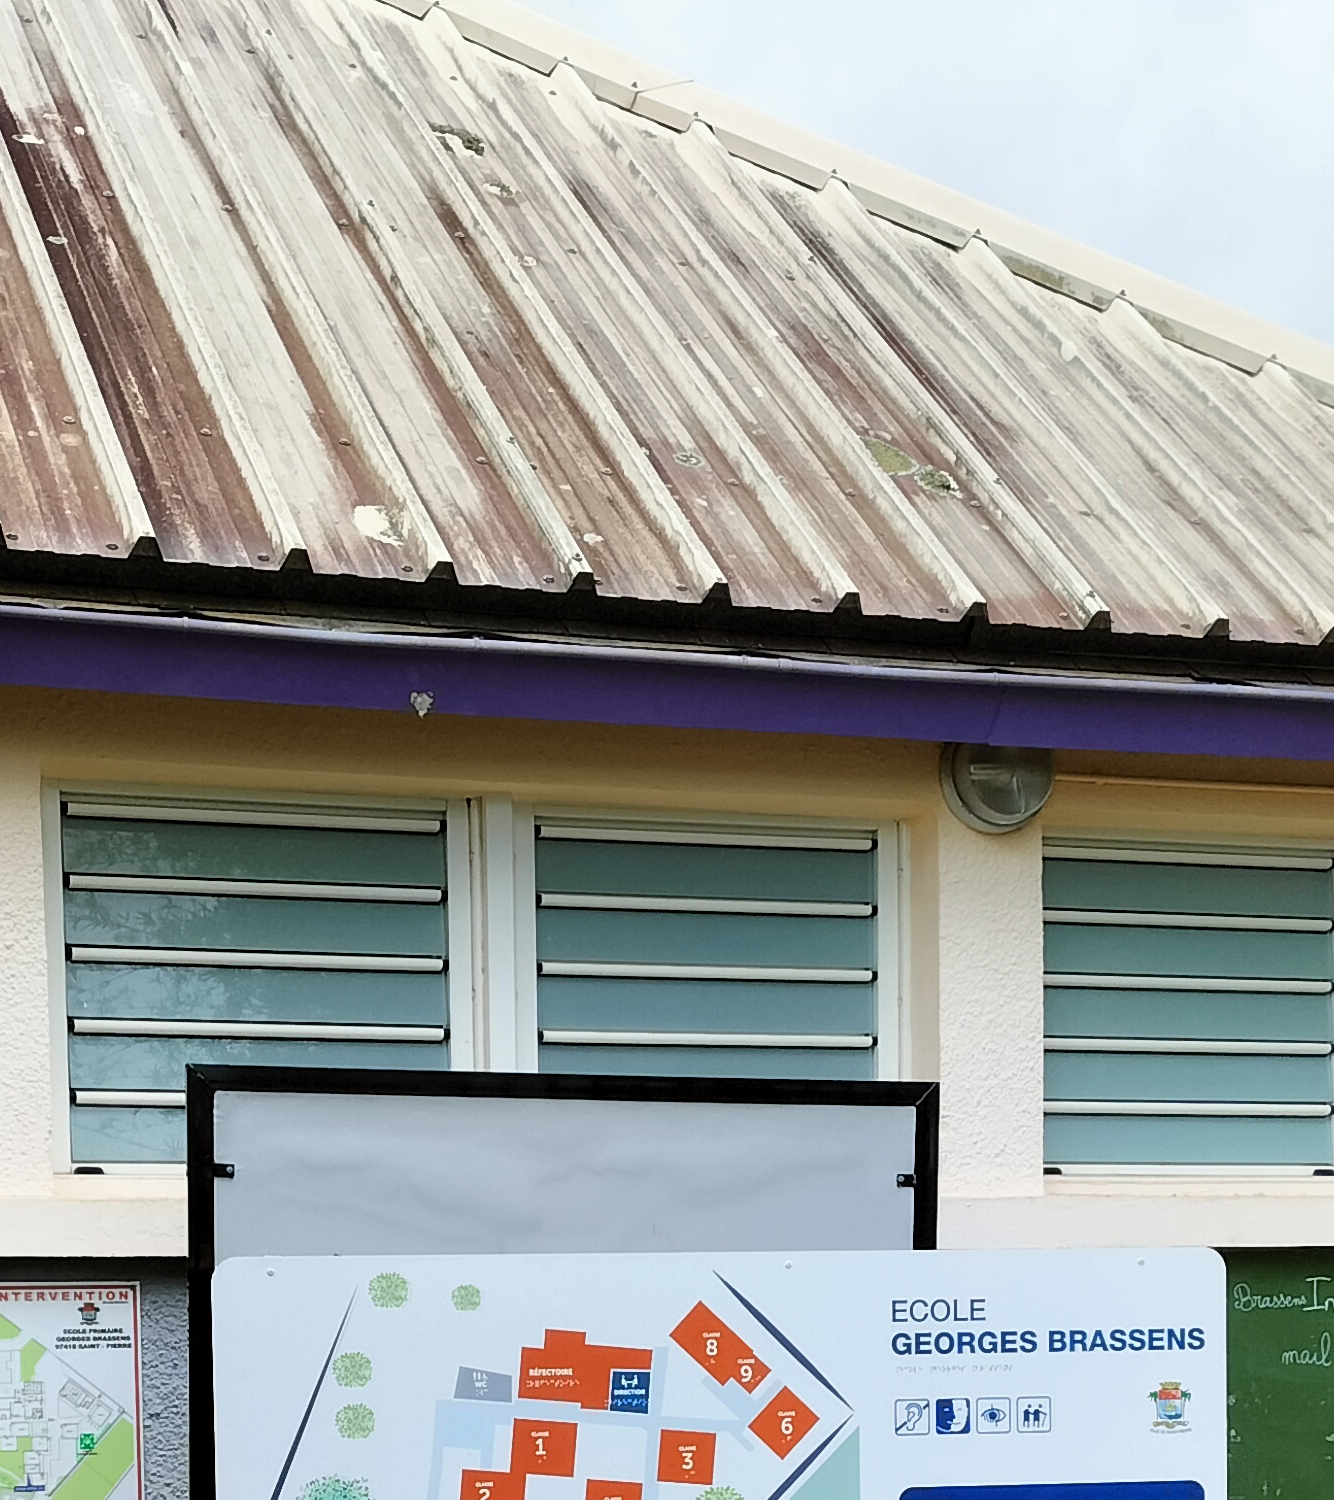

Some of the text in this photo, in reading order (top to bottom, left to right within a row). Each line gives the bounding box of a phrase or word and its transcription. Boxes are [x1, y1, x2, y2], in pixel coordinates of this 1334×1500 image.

[1233, 1283, 1307, 1311] Brassens
[891, 1298, 987, 1323] ECOLE
[705, 1339, 718, 1356] 8
[891, 1327, 1206, 1356] GEORGES BRASSENS
[1281, 1332, 1333, 1367] mail
[528, 1367, 573, 1376] RÉFECTOIRE
[740, 1365, 753, 1383] 9
[780, 1417, 793, 1435] 6
[535, 1438, 547, 1455] 1
[682, 1452, 694, 1470] 3
